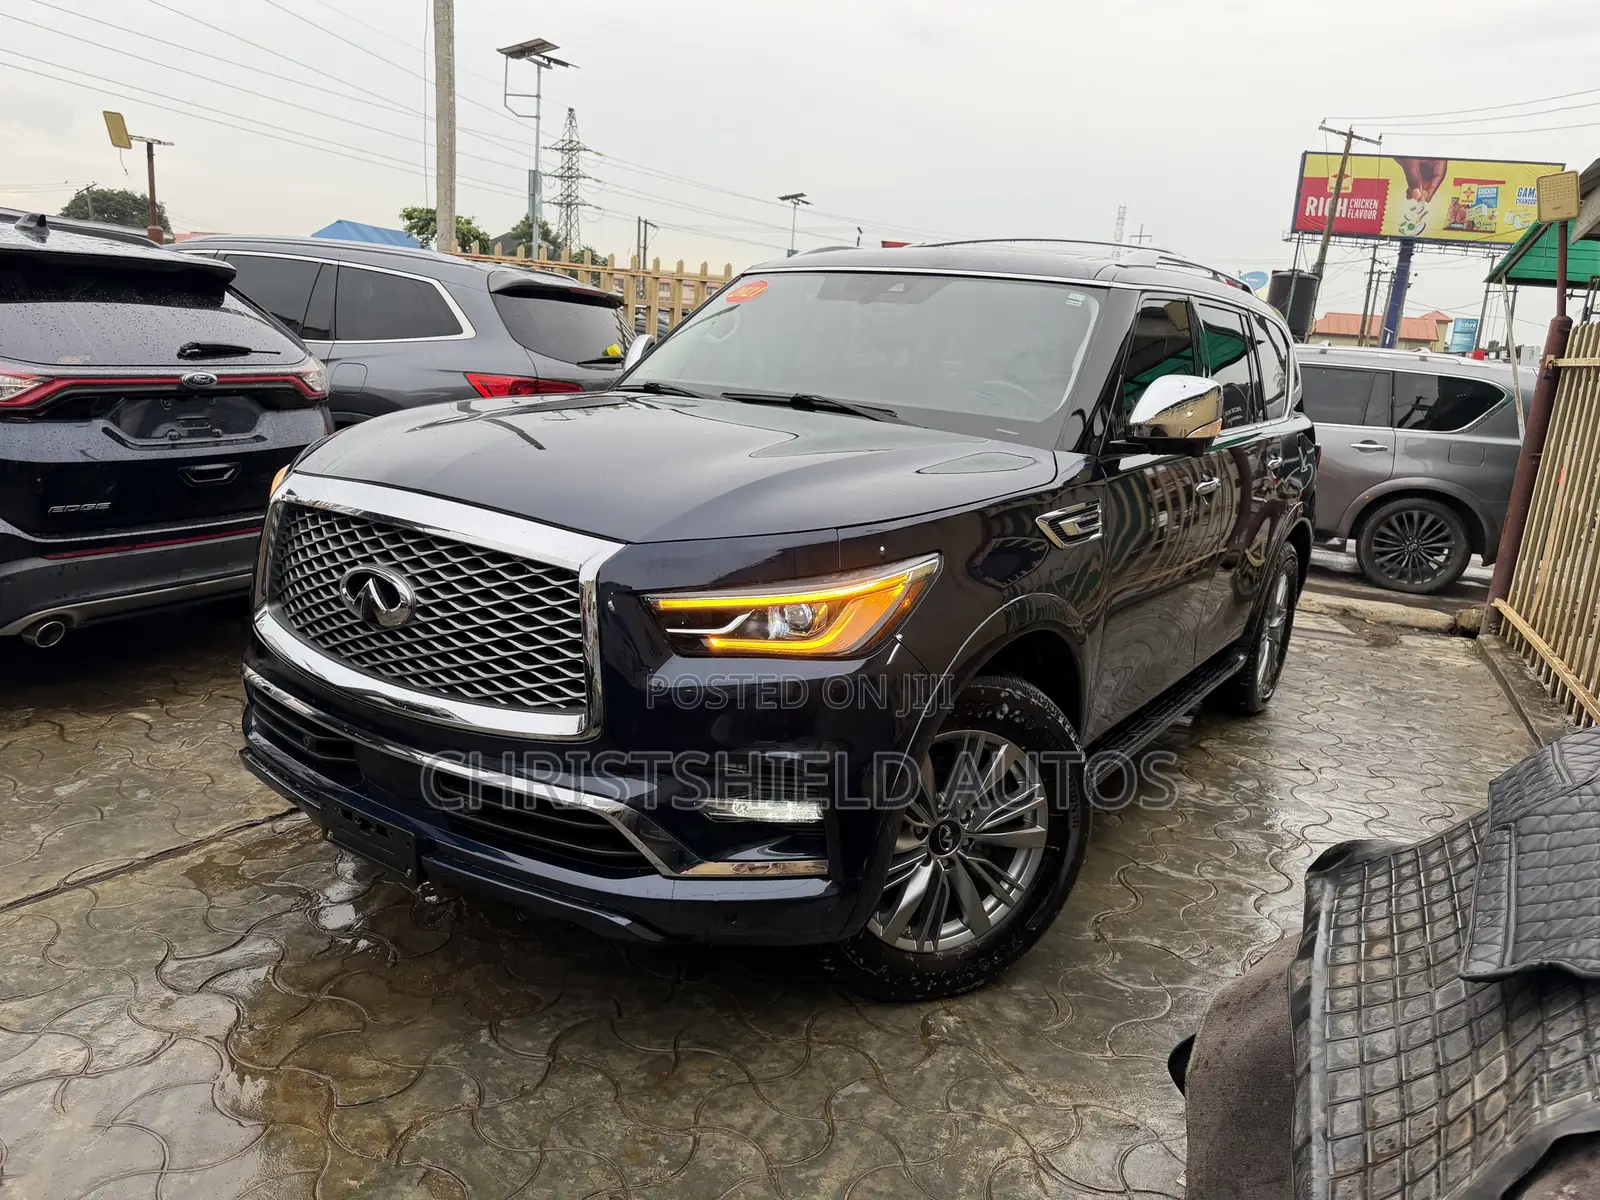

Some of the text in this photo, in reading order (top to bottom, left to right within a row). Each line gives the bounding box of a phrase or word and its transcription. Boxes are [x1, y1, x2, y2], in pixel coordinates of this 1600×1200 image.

[1517, 187, 1537, 198] GAM
[1349, 198, 1379, 209] CHICKEN
[1347, 208, 1378, 220] FLAVOUR
[192, 374, 211, 384] Ford
[47, 502, 111, 513] EDGE
